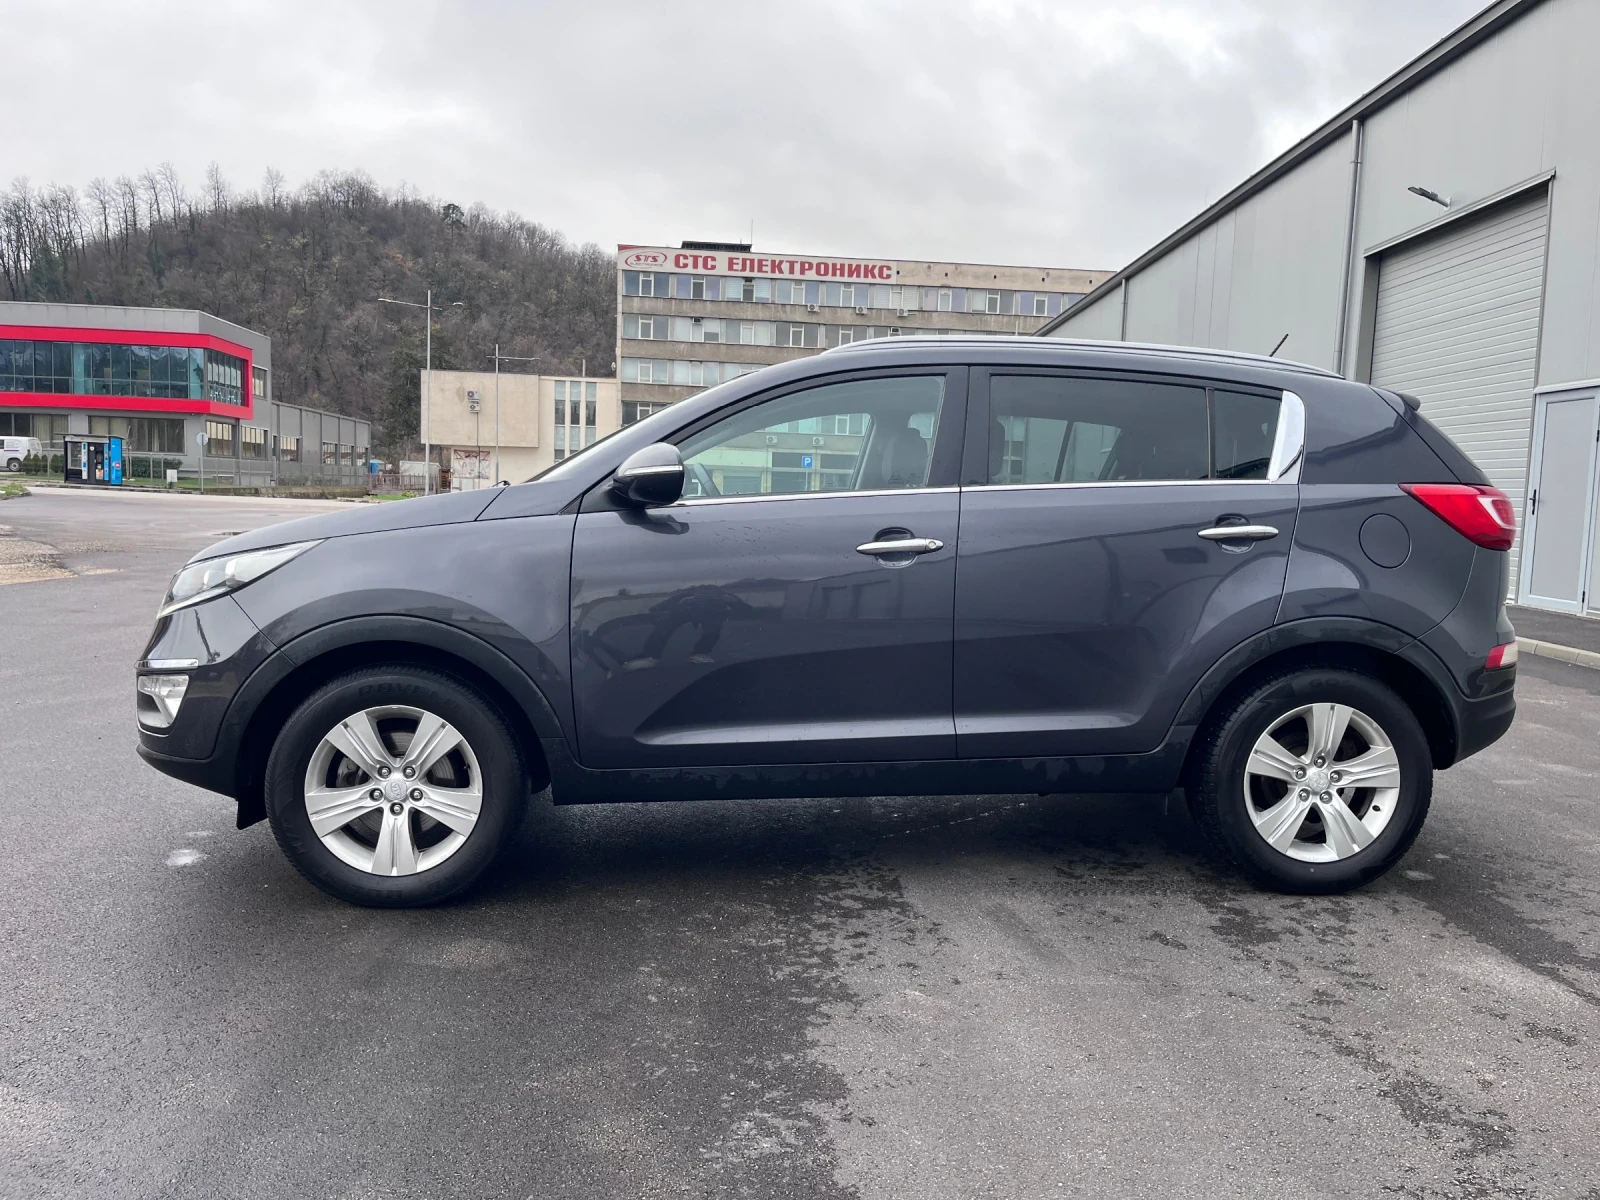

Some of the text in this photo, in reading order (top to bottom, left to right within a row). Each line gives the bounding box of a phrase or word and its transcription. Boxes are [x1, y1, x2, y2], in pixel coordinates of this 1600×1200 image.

[633, 254, 660, 263] STS
[674, 253, 893, 279] СТС ЕЛЕКТРОНИКС
[804, 457, 811, 466] P
